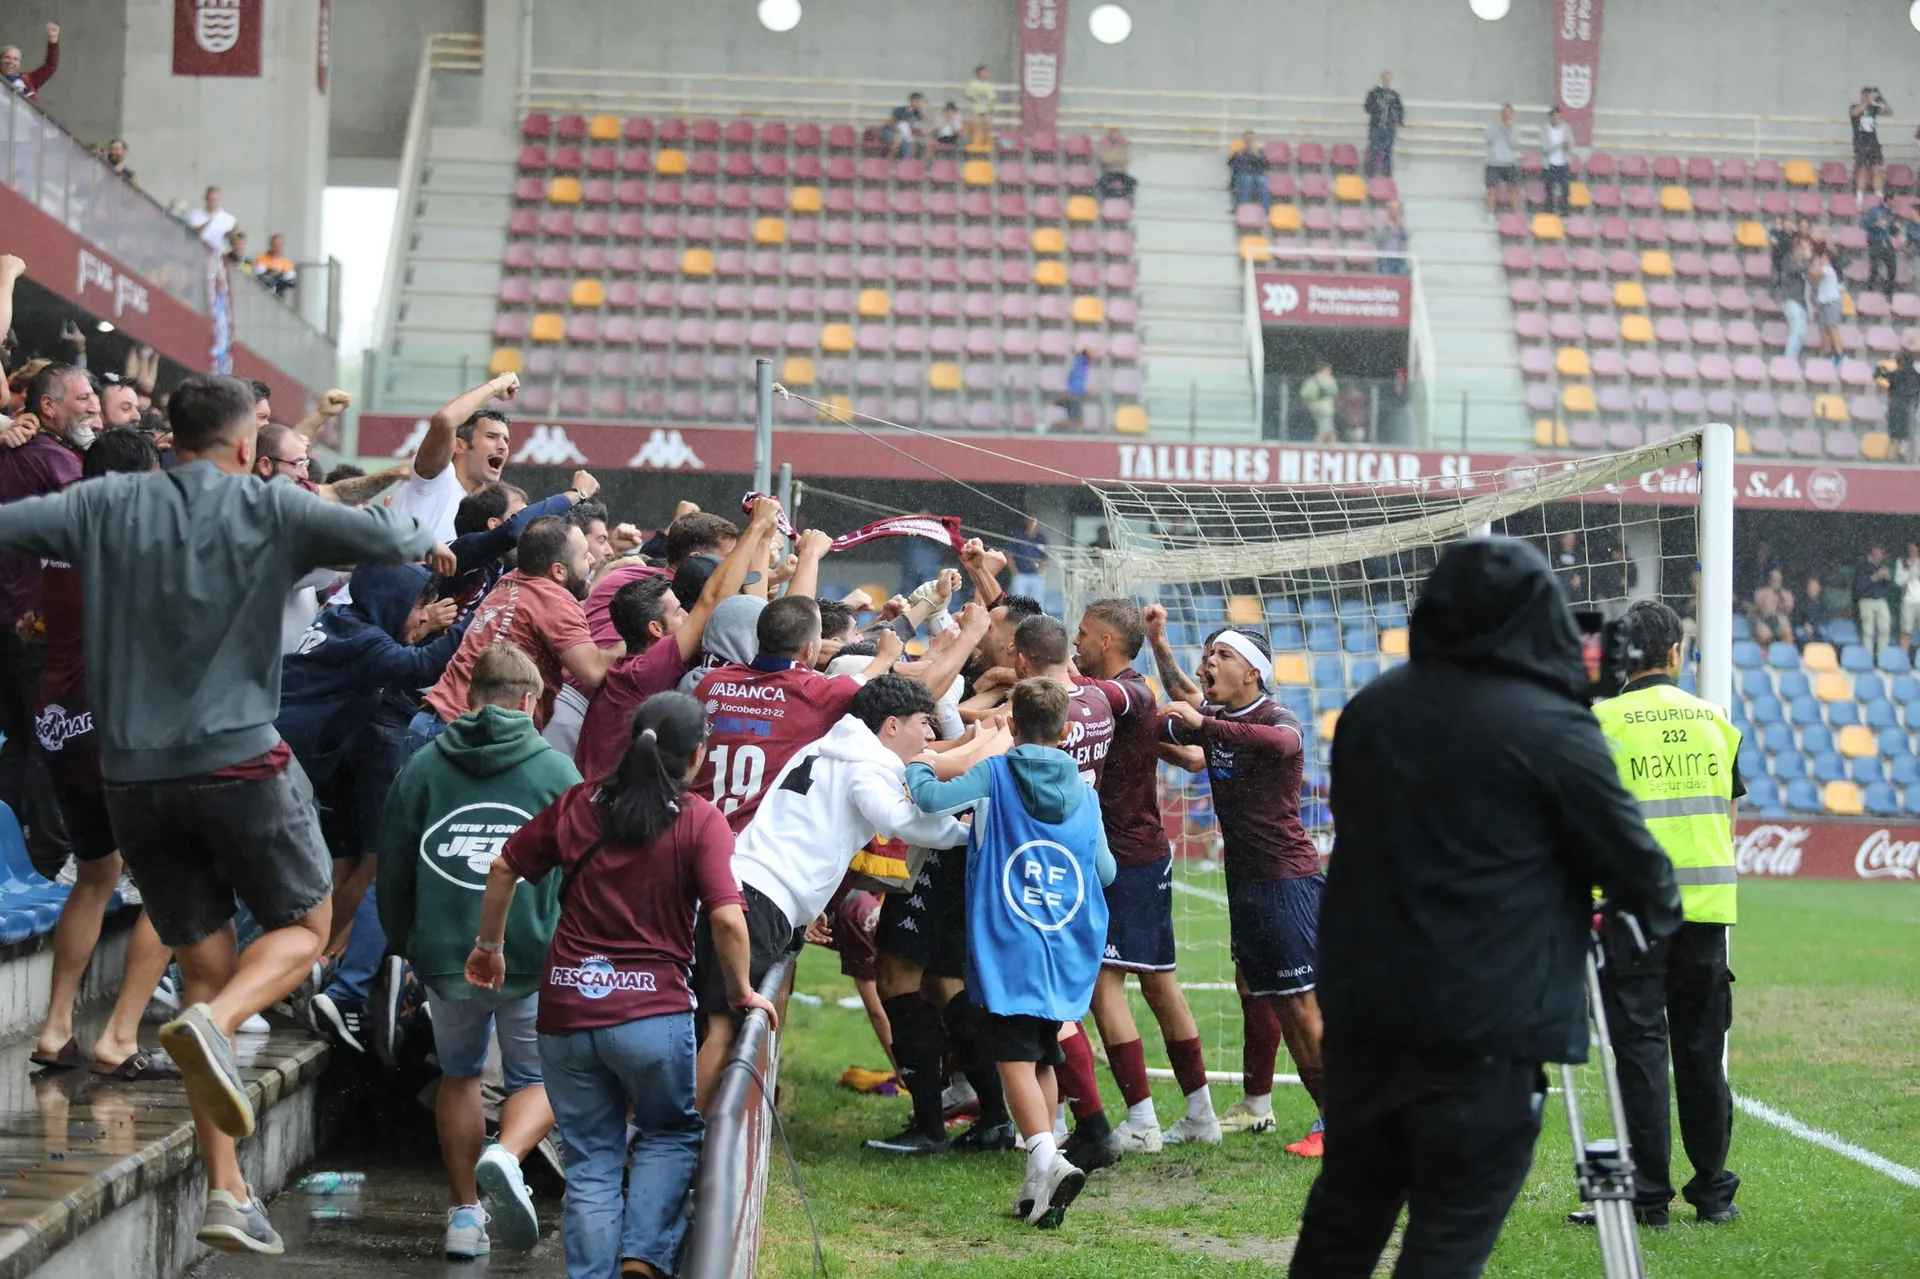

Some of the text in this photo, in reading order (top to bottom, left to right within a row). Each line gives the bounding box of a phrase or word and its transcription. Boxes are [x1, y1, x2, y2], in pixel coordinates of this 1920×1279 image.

[1118, 445, 1270, 483] TALLERES
[1439, 455, 1476, 490] SL
[1745, 471, 1802, 499] S.A.
[709, 682, 786, 702] ABANCA
[720, 703, 762, 715] Xacobeo
[1623, 708, 1714, 724] SEGURIDAD
[1662, 729, 1688, 743] 232
[708, 744, 766, 806] 19
[1650, 777, 1708, 793] Seguridad
[448, 824, 524, 833] NEW YOR
[437, 836, 510, 858] JET
[1733, 825, 1811, 876] Cola
[550, 966, 658, 992] PESCAMAR
[1277, 964, 1314, 979] ABANCA
